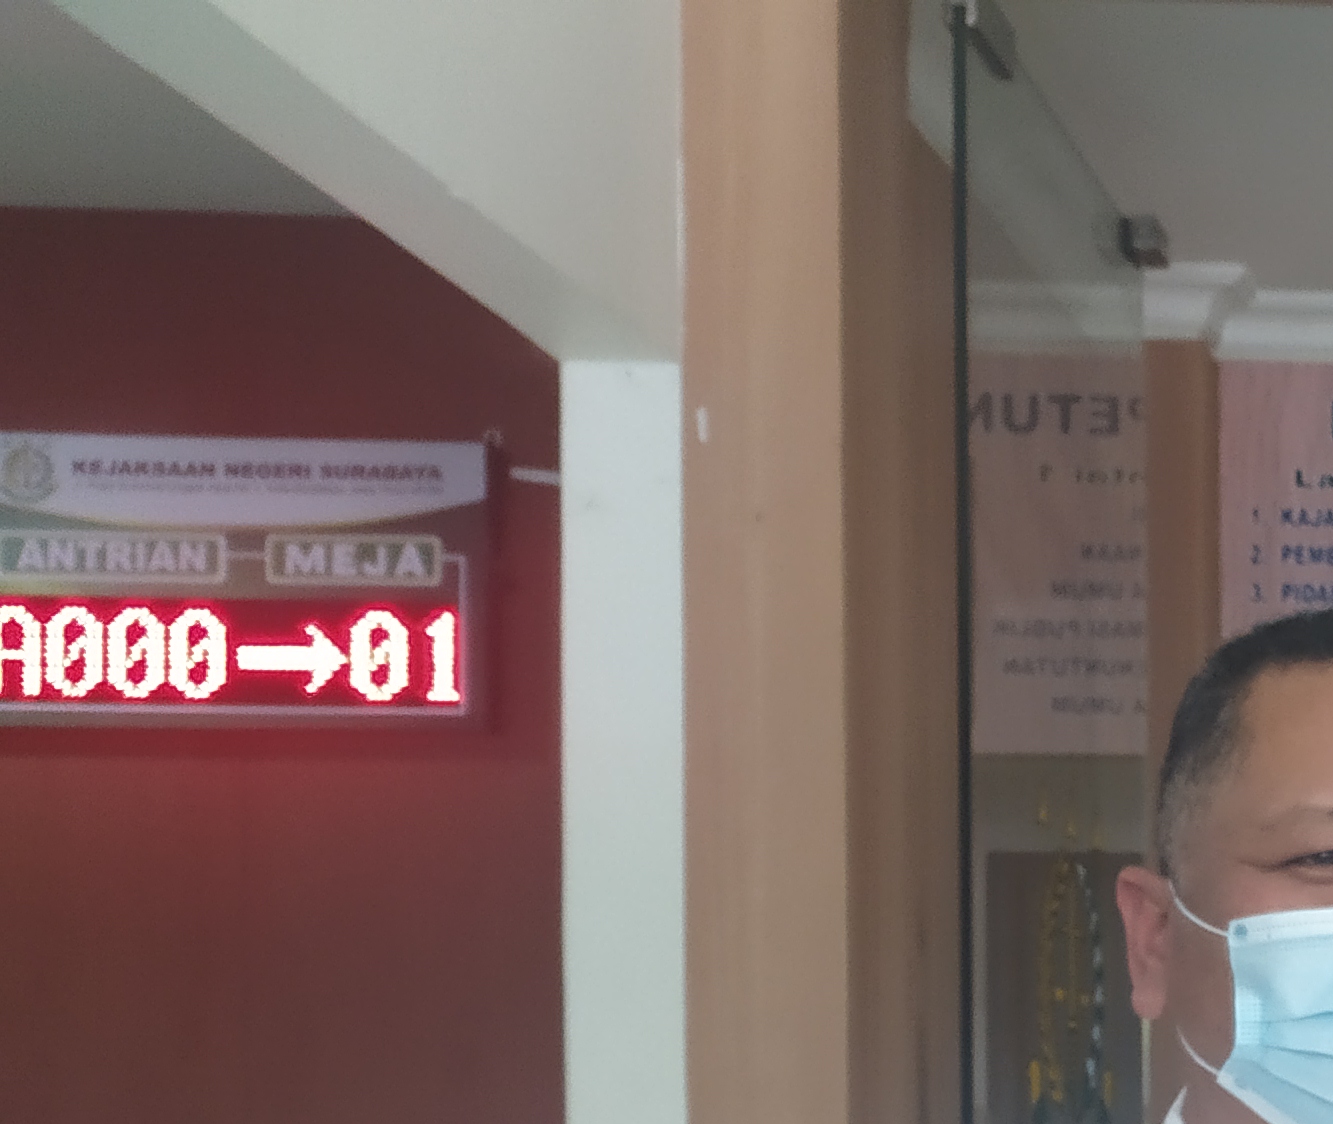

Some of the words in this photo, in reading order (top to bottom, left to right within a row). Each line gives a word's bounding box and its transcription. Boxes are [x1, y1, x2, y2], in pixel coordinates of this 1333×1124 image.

[71, 459, 217, 478] KEJAKSAAN
[223, 461, 312, 480] NEGERI
[320, 462, 444, 482] SURABAYA
[16, 539, 208, 573] ANTRIAN
[284, 542, 426, 578] MEJA
